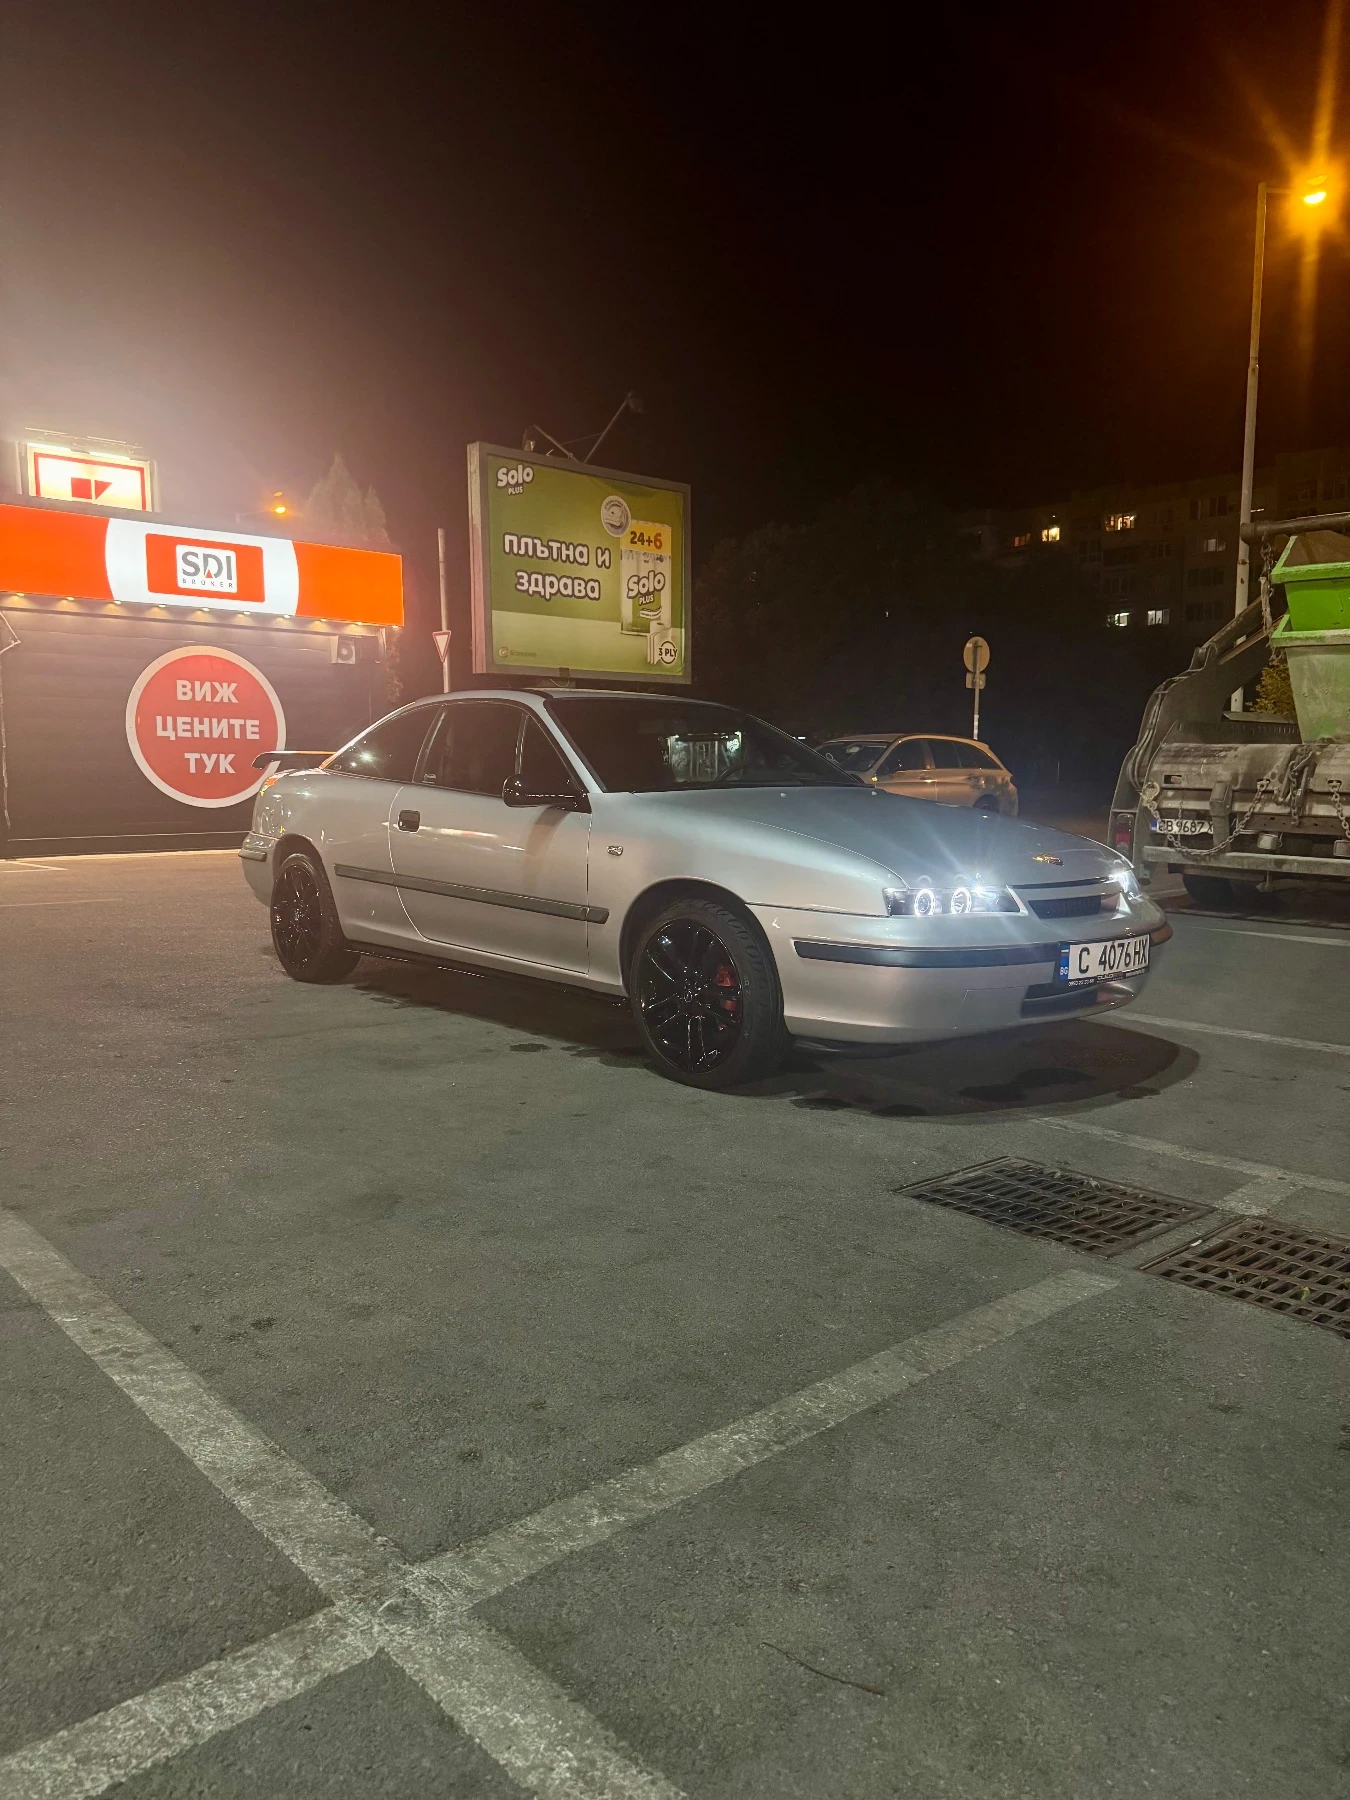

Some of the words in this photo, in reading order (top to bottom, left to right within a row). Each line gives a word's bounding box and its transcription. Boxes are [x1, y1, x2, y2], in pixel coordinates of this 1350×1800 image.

[496, 464, 534, 487] Solo
[508, 486, 523, 495] PLUS
[503, 532, 589, 567] плътна
[595, 546, 611, 569] и
[630, 531, 663, 550] 24+6
[181, 551, 233, 581] SDI
[182, 578, 234, 588] BROKER
[515, 570, 600, 601] здрава
[626, 570, 666, 599] Solo
[638, 595, 654, 606] PLUS
[658, 648, 663, 656] 3
[665, 648, 678, 658] PLY
[176, 679, 238, 704] ВИЖ
[156, 715, 260, 741] ЦЕНИТЕ
[185, 753, 236, 774] ТУК
[1176, 820, 1205, 833] 9687
[1078, 946, 1090, 974] C
[1098, 941, 1131, 971] 4076
[1133, 938, 1148, 967] HX
